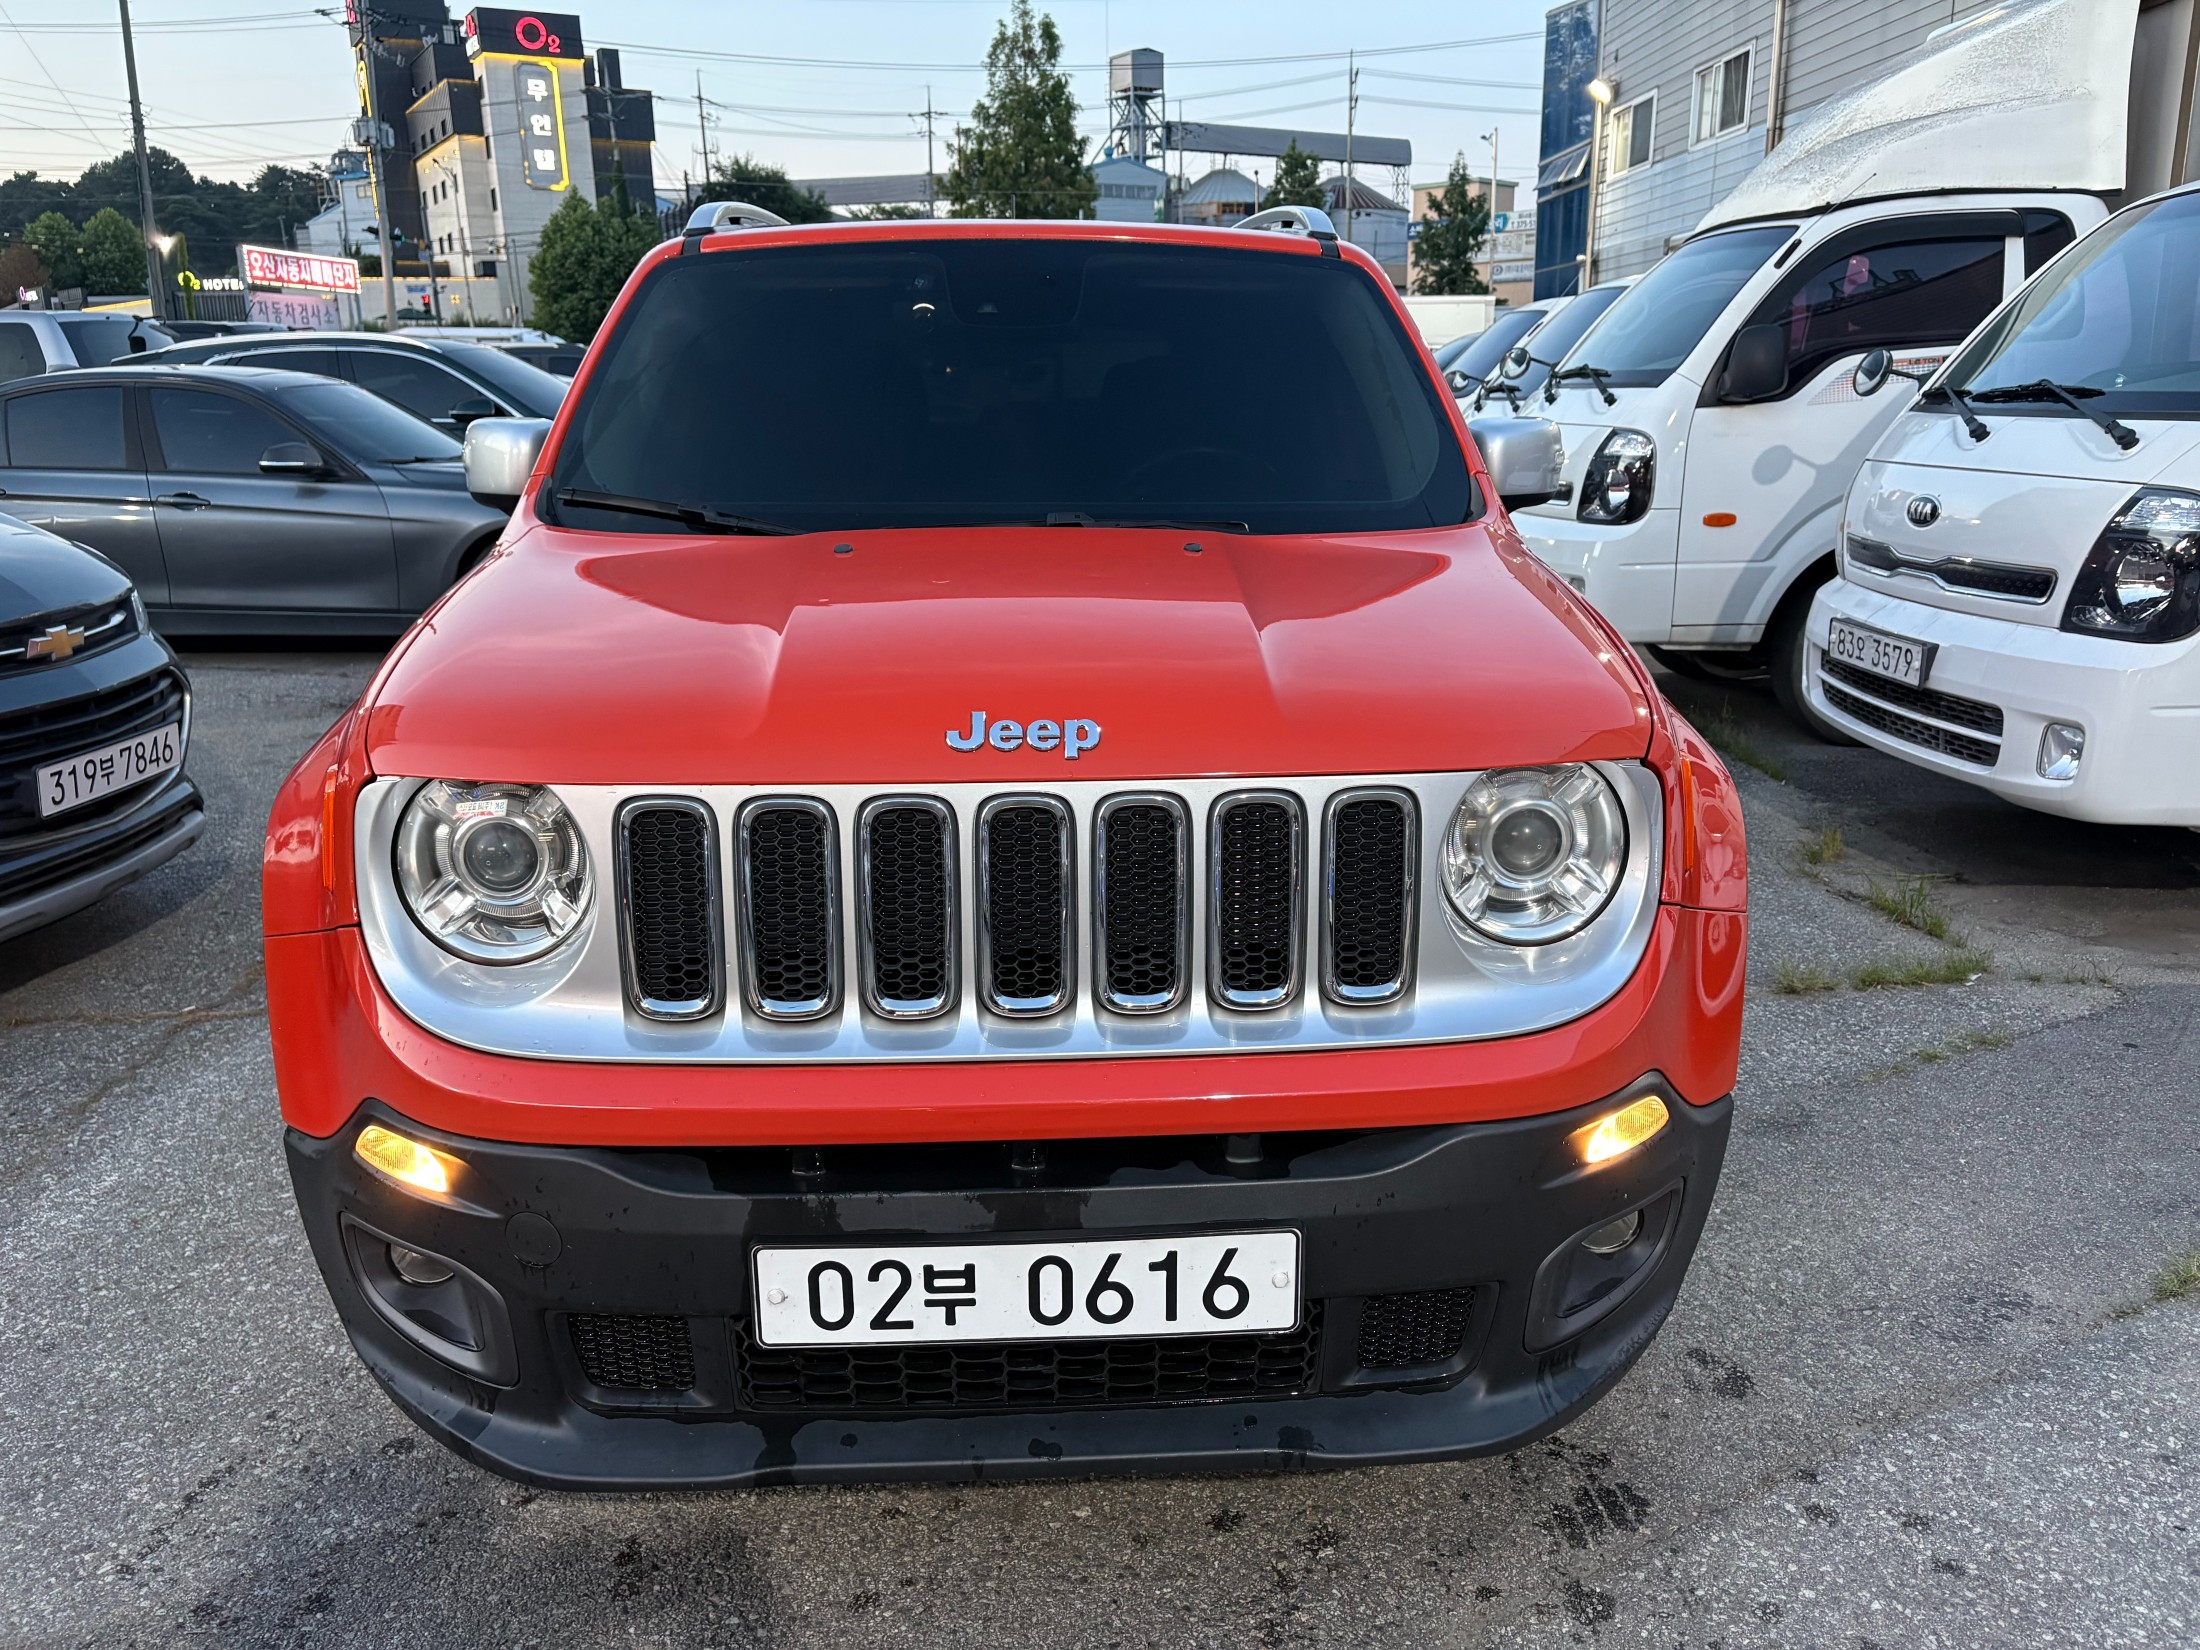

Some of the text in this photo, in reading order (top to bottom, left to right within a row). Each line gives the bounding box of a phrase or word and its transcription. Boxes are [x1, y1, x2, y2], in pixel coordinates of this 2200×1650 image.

[515, 16, 561, 54] O2
[256, 300, 335, 326] 자동차검사소
[1908, 501, 1932, 521] KIA
[1837, 629, 1914, 677] 83오 3579
[946, 711, 1102, 760] Jeep
[49, 731, 174, 805] 319부 7846
[807, 1247, 1251, 1332] 02부 0616
